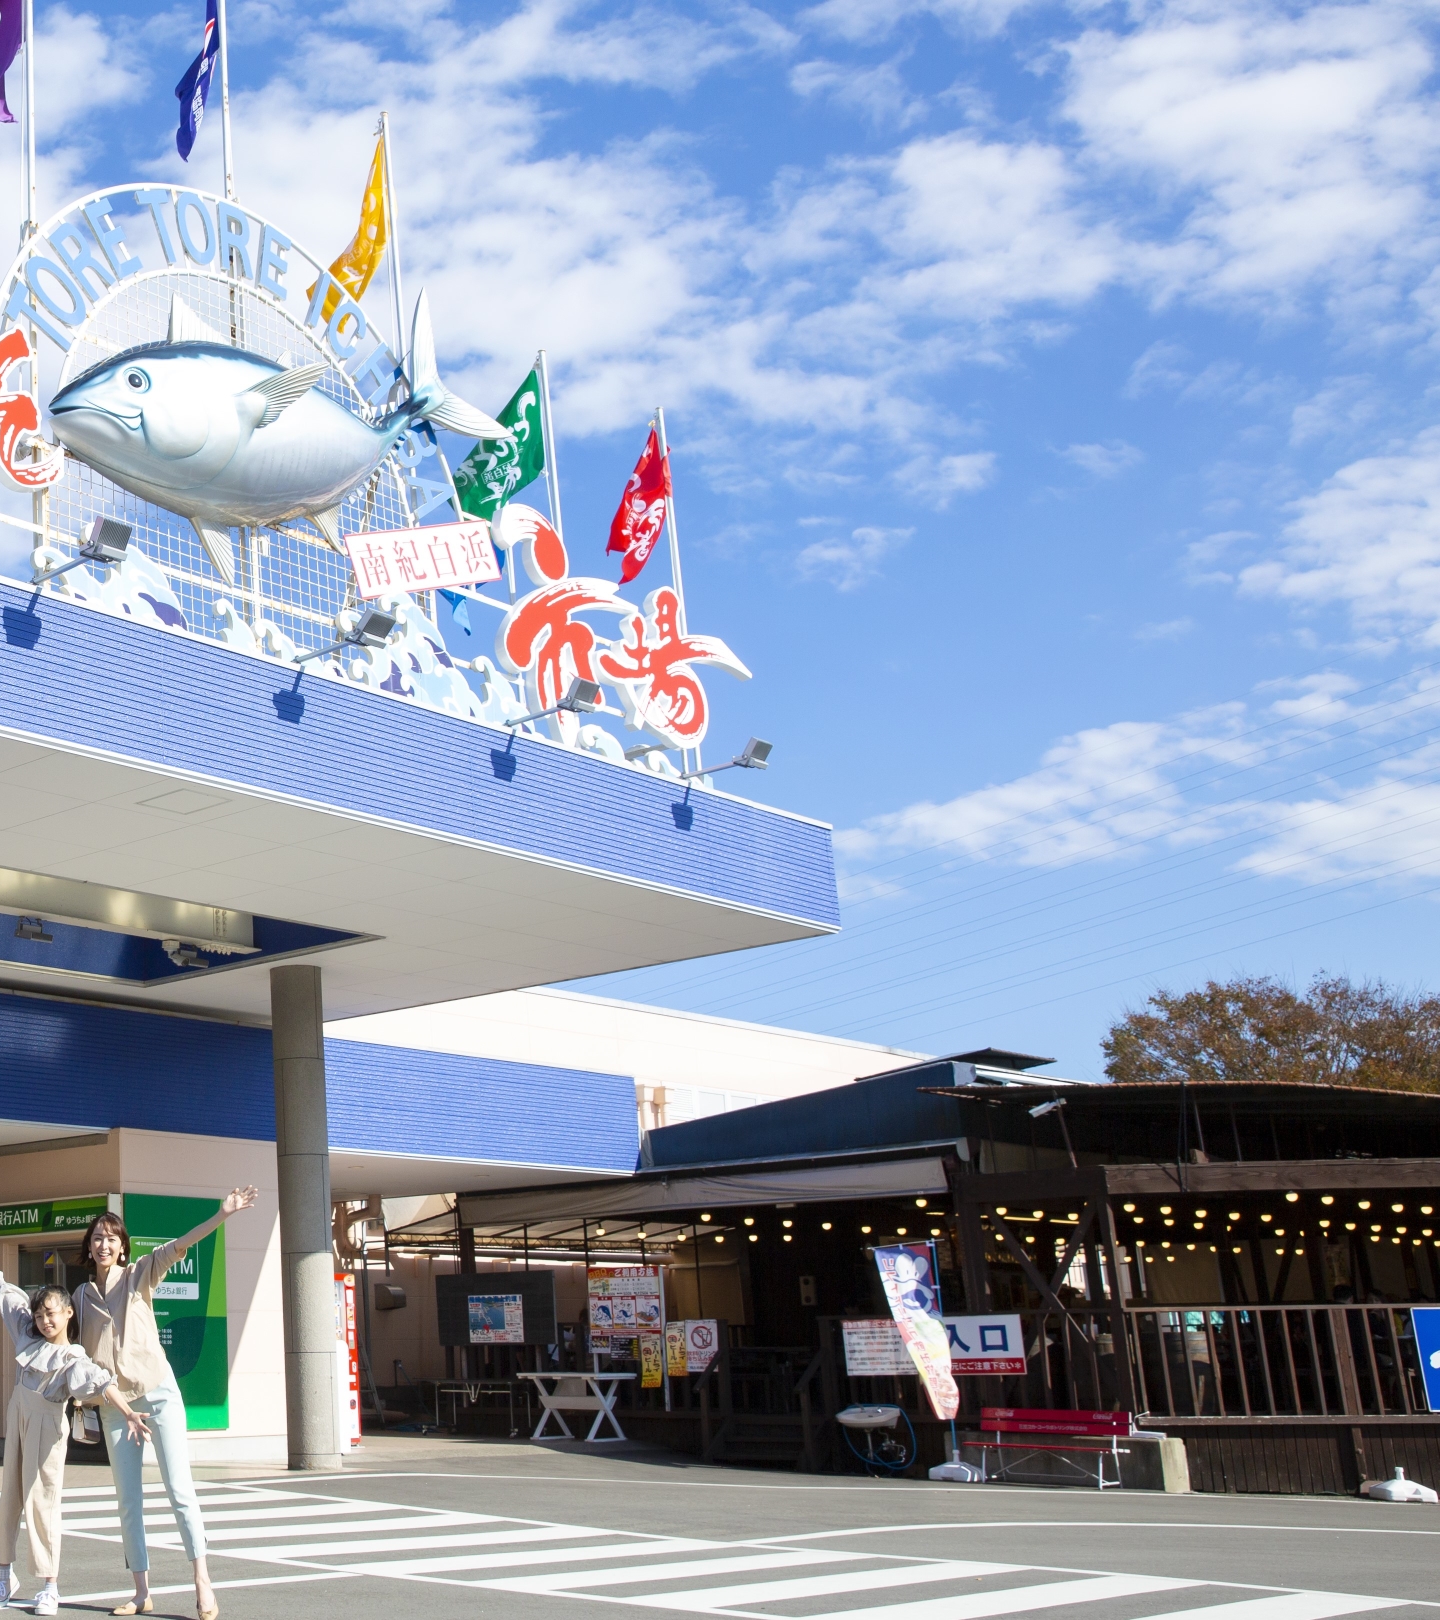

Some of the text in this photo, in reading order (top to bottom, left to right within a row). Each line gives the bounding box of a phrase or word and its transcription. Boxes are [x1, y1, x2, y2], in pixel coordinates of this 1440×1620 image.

[4, 189, 455, 520] TORE TORE ICHBA
[356, 531, 492, 588] 南紀白浜
[66, 1214, 97, 1226] ゆうちょ銀行
[155, 1286, 188, 1296] ゆうちょ銀行
[946, 1324, 1009, 1352] 入口
